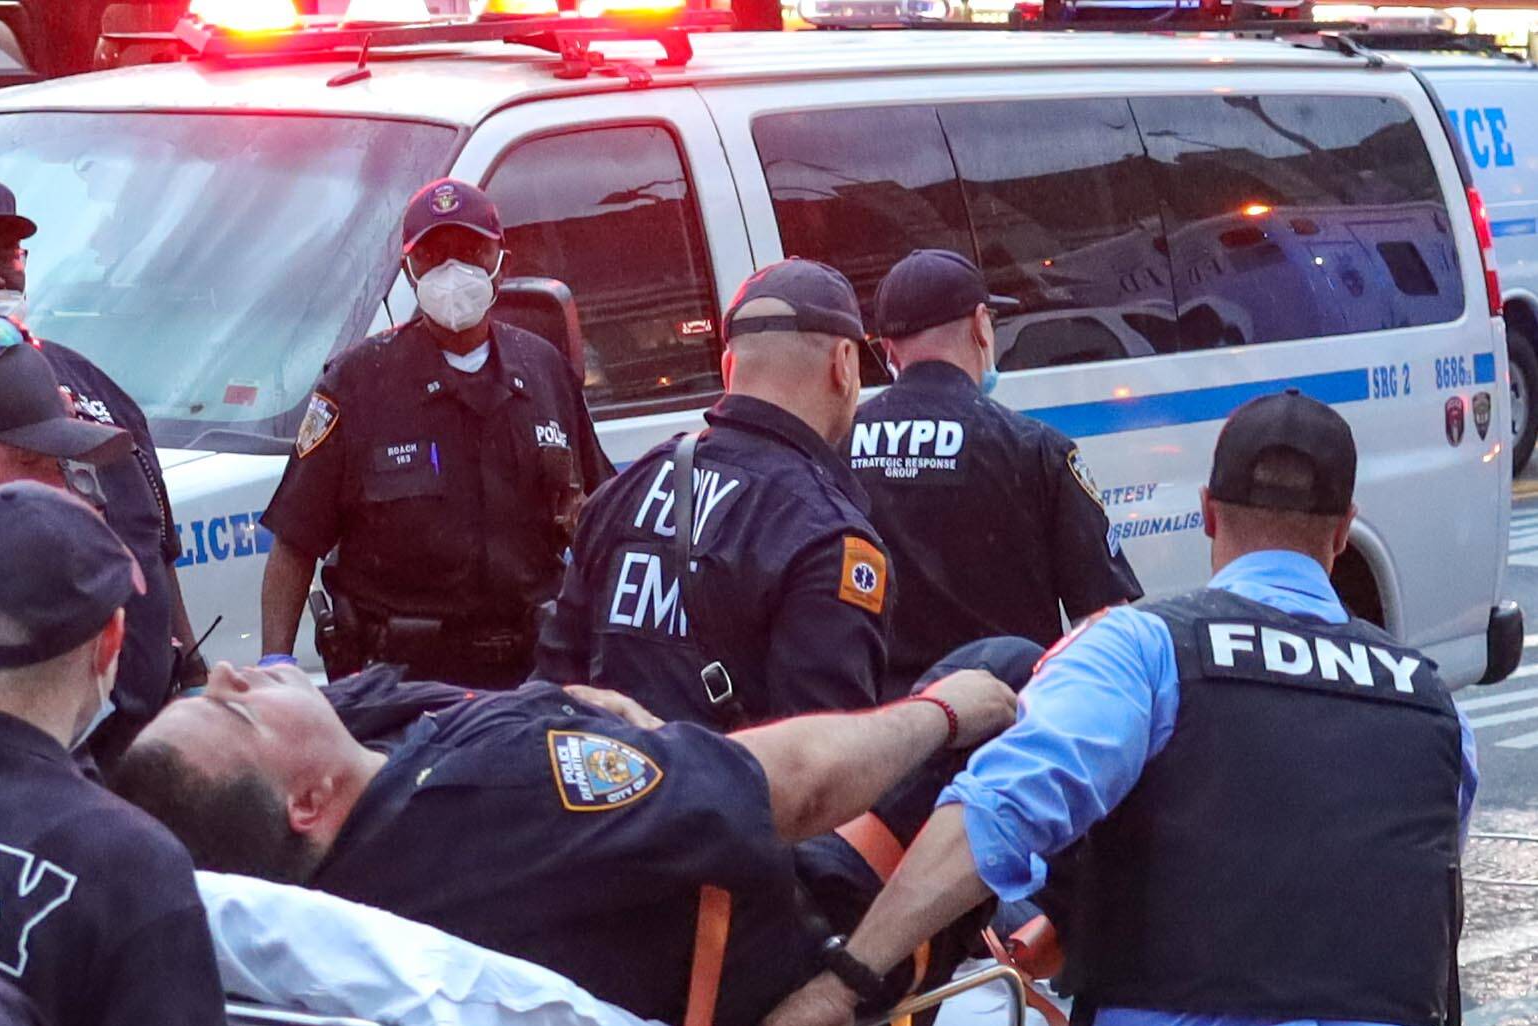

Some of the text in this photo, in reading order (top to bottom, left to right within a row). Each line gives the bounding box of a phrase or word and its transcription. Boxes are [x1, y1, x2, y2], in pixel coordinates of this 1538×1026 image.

[1373, 364, 1397, 399] SRG
[1403, 362, 1410, 396] 2
[387, 443, 418, 457] ROACH
[851, 420, 964, 457] NYPD
[851, 457, 956, 470] STRATEGIC RESPONSE
[885, 467, 918, 478] GROUP
[1102, 483, 1157, 506] RTESY
[174, 512, 253, 567] LICE
[609, 552, 698, 637] EM
[1208, 623, 1421, 693] FDNY
[557, 745, 577, 784] POLICE
